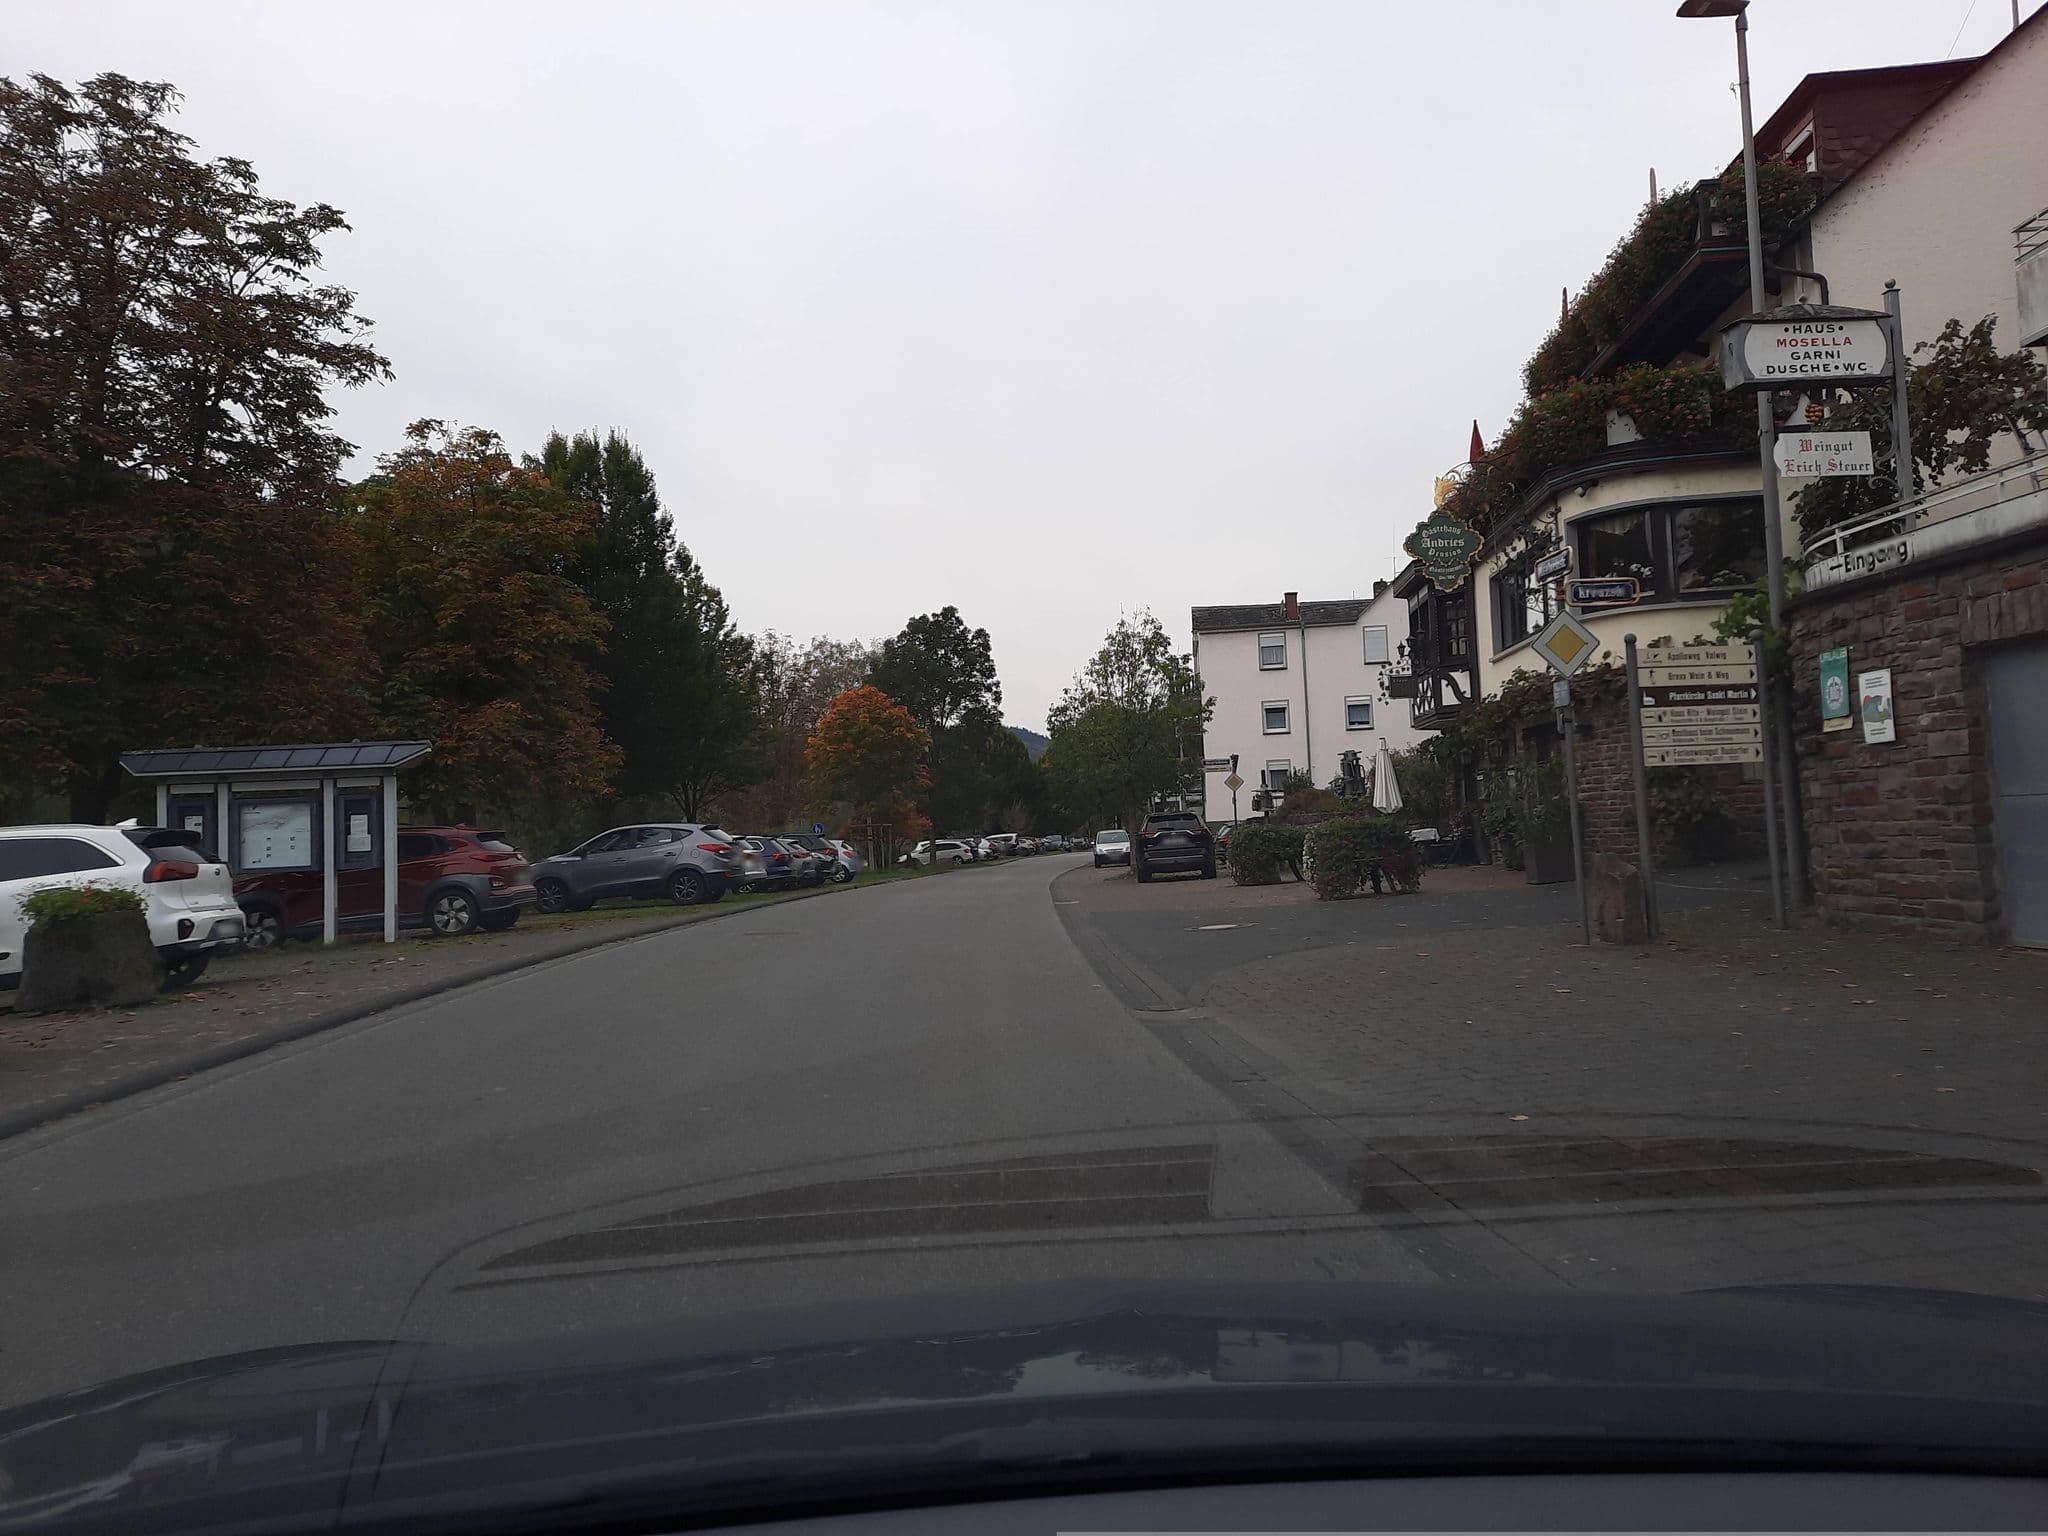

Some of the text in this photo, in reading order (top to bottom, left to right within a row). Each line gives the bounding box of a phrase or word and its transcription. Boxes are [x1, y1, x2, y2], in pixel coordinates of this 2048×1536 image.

[1792, 323, 1835, 334] HAUS
[1776, 336, 1853, 348] MOSELLA
[1790, 350, 1841, 361] GARNI
[1766, 362, 1867, 375] DUSCHE WC
[1798, 438, 1853, 455] Weingut
[1784, 458, 1871, 476] Erich Steuer
[1421, 538, 1465, 548] Andries
[1428, 548, 1462, 558] Pension
